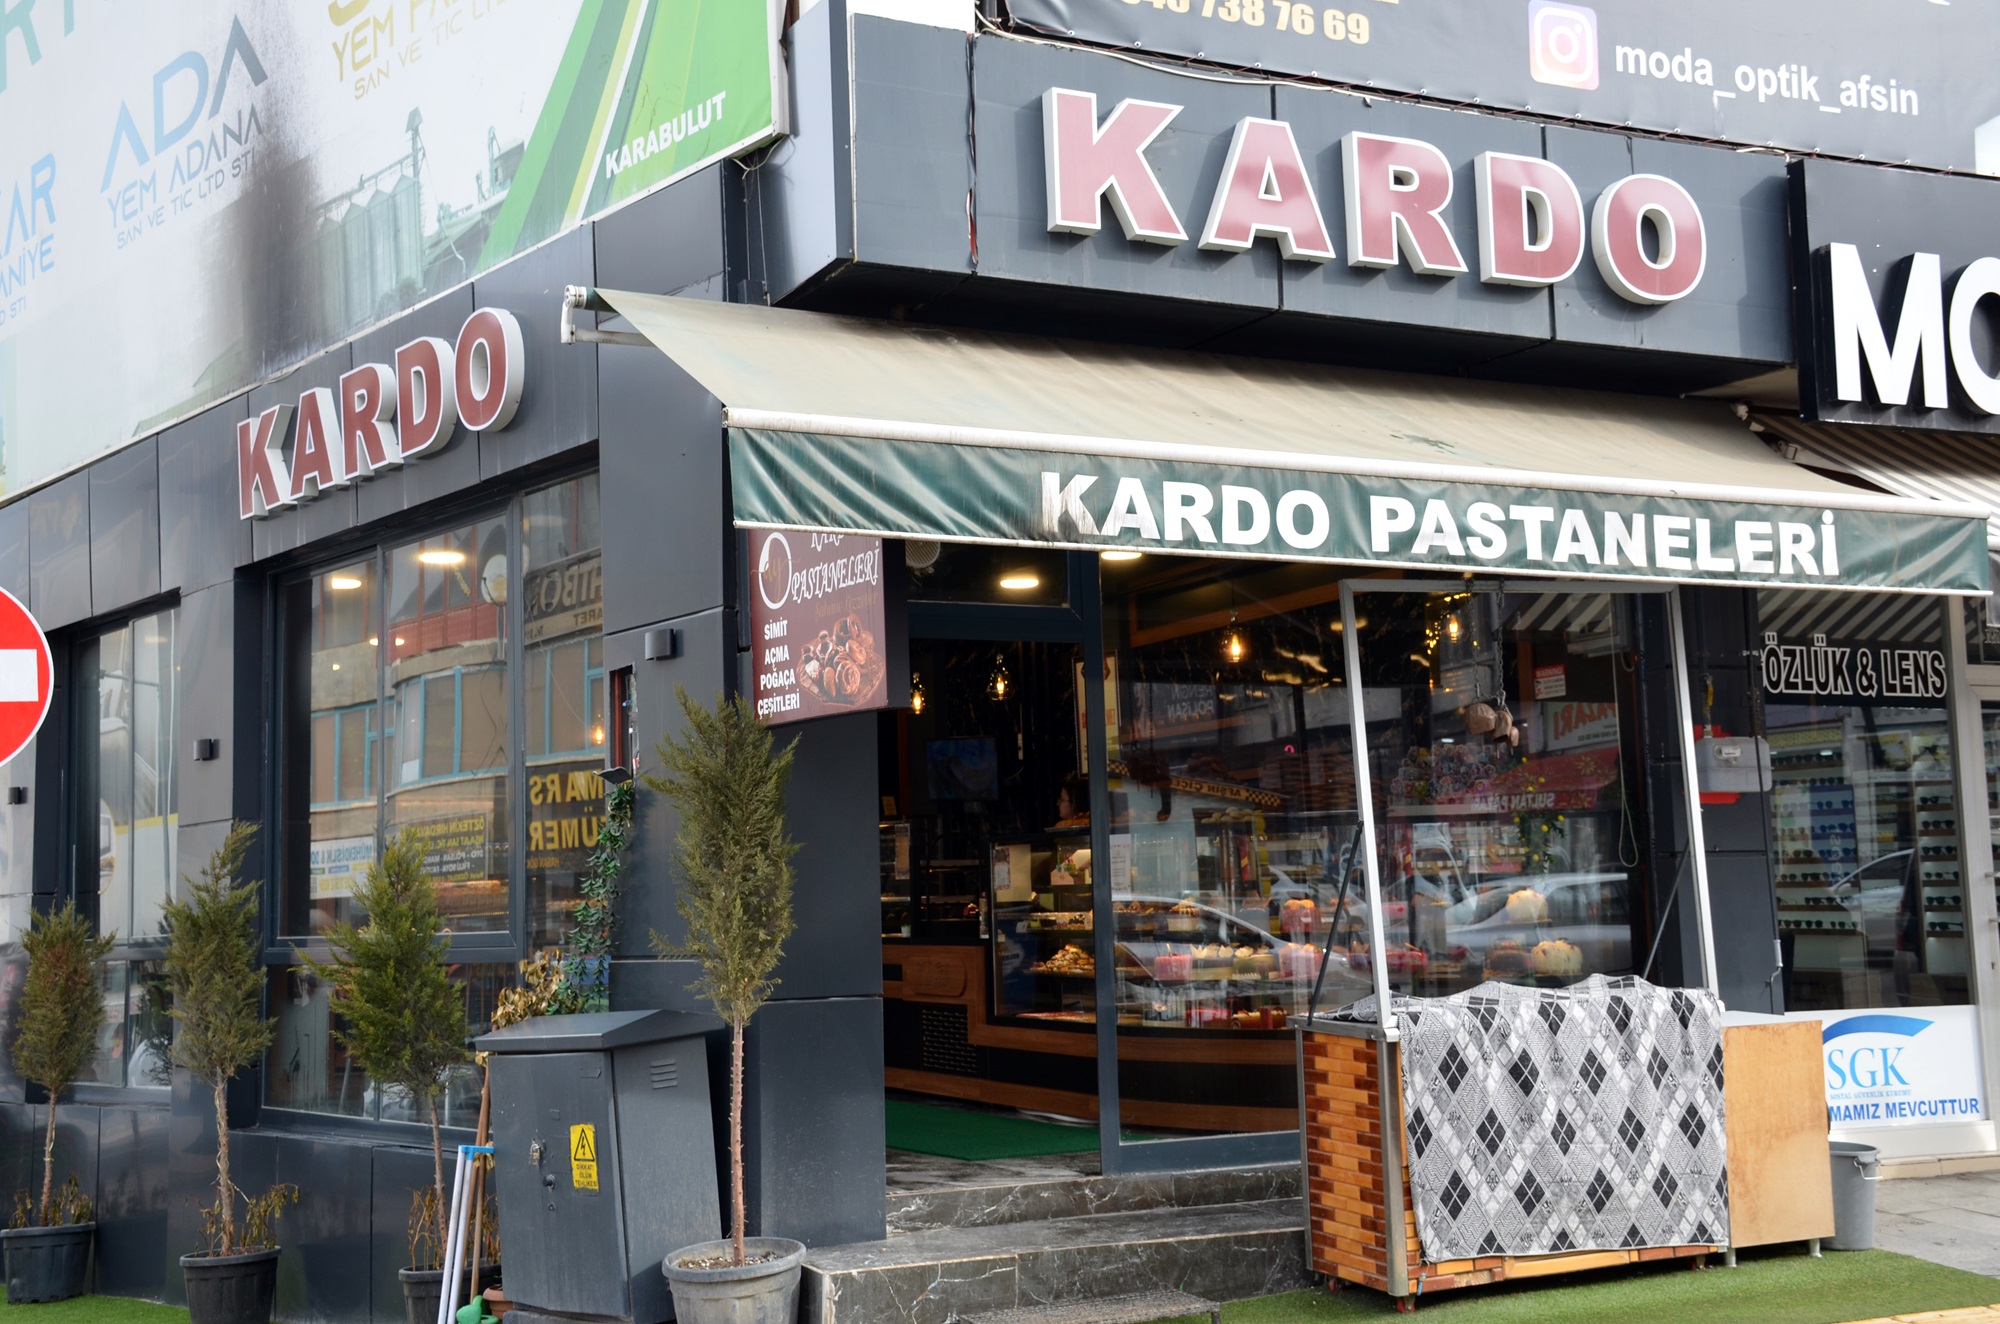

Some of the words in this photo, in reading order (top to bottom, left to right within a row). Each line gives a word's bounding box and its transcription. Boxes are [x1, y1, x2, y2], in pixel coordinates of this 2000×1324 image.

[332, 4, 394, 82] YEM
[1272, 0, 1315, 35] 76
[1323, 8, 1370, 45] 69
[354, 59, 390, 101] SAN
[397, 37, 423, 69] VE
[1615, 45, 1920, 116] moda_optik_afsin
[100, 14, 268, 193] ADA
[605, 90, 726, 180] KARABULUT
[107, 168, 157, 229] YEM
[169, 103, 262, 194] ADANA
[1042, 86, 1707, 304] KARDO
[0, 153, 57, 261] AR
[117, 220, 142, 250] SAN
[147, 206, 166, 229] VE
[198, 169, 225, 199] LTD
[236, 307, 524, 520] KARDO
[1041, 471, 1330, 549] KARDO
[1369, 495, 1841, 576] PASTANELERİ
[791, 540, 880, 604] PASTANELERİ
[764, 617, 788, 640] SİMİT
[764, 645, 790, 670] AÇMA
[760, 666, 796, 690] POĞAÇA
[1760, 632, 1853, 696] ÖZLÜK
[1856, 648, 1878, 698] &
[1881, 649, 1948, 698] LENS
[757, 689, 800, 720] ÇEŞİTLERİ
[1827, 1047, 1911, 1090] SGK
[1830, 1092, 1852, 1101] SOSYAL
[1885, 1097, 1980, 1119] MEVCUTTUR
